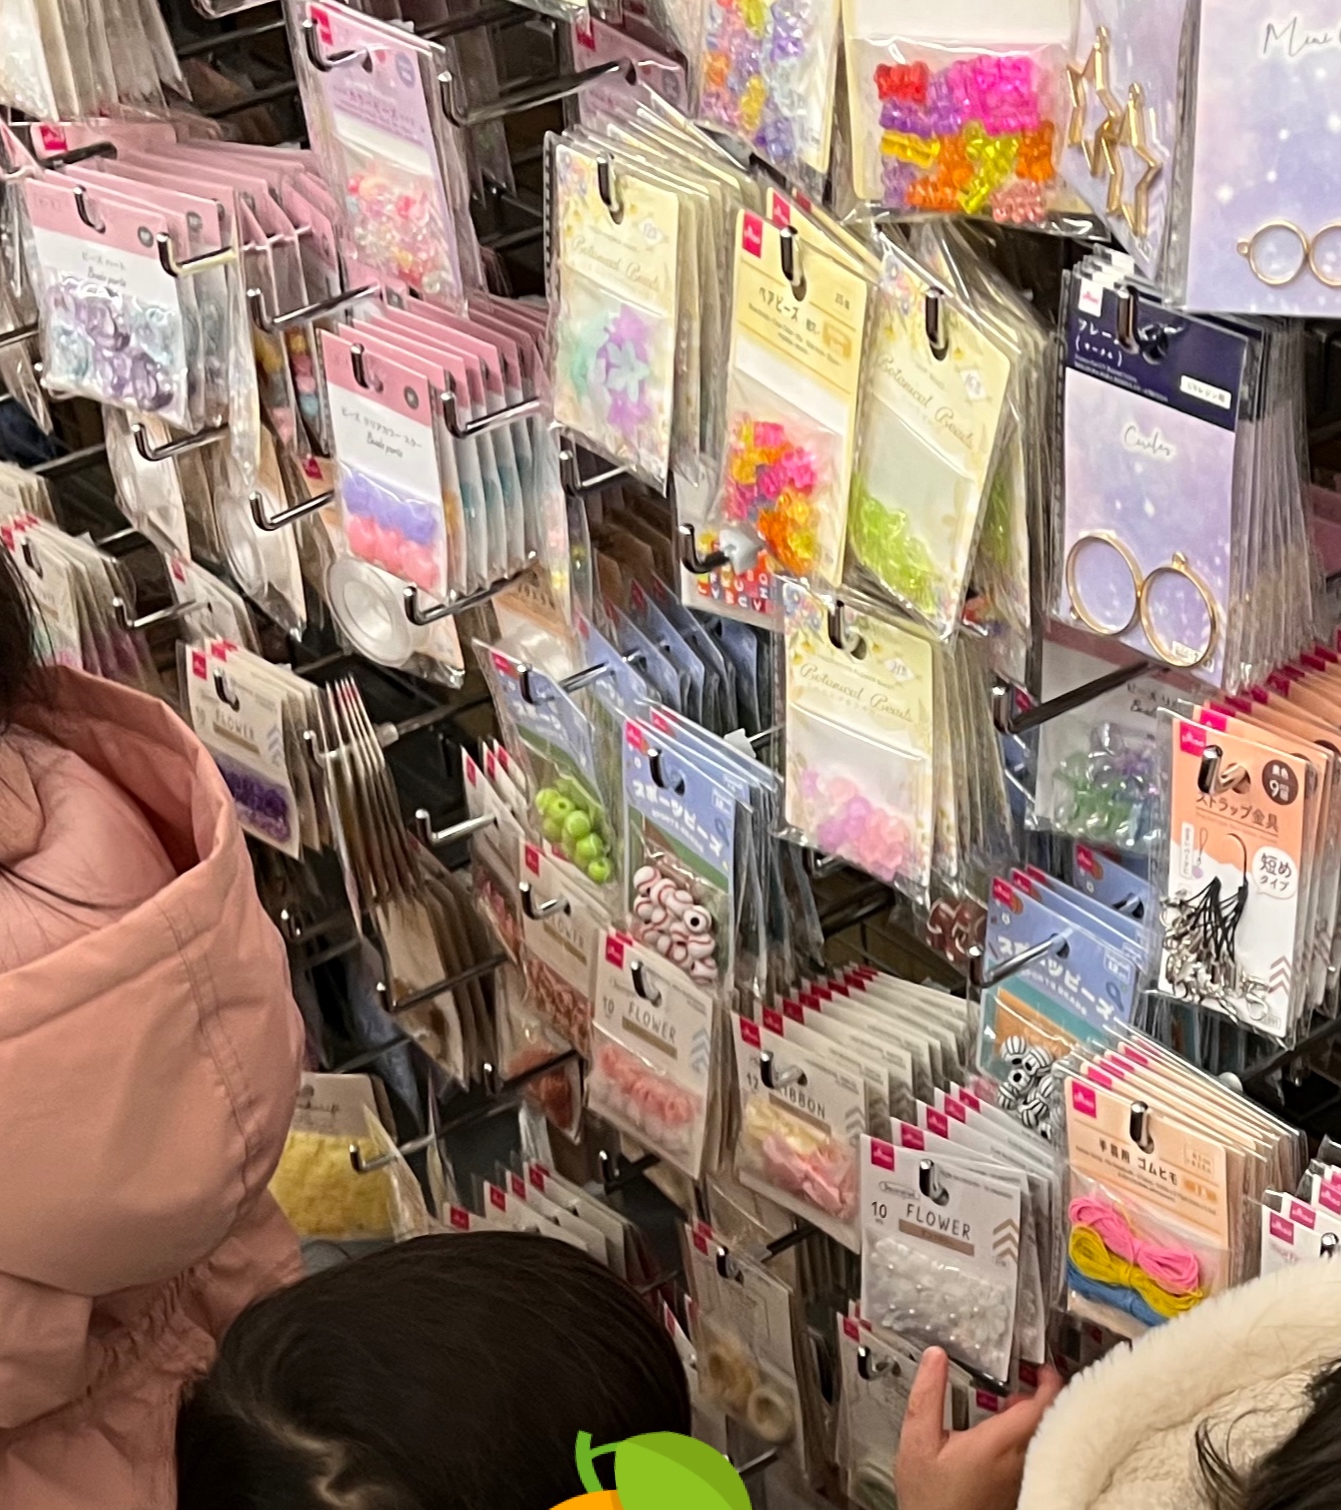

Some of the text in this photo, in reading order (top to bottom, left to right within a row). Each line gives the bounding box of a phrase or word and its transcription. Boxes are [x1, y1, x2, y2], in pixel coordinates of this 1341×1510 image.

[1259, 852, 1293, 879] 短め
[1260, 874, 1290, 892] タイプ
[628, 1002, 677, 1044] FLOWER
[871, 1200, 971, 1241] 10 FLOWER
